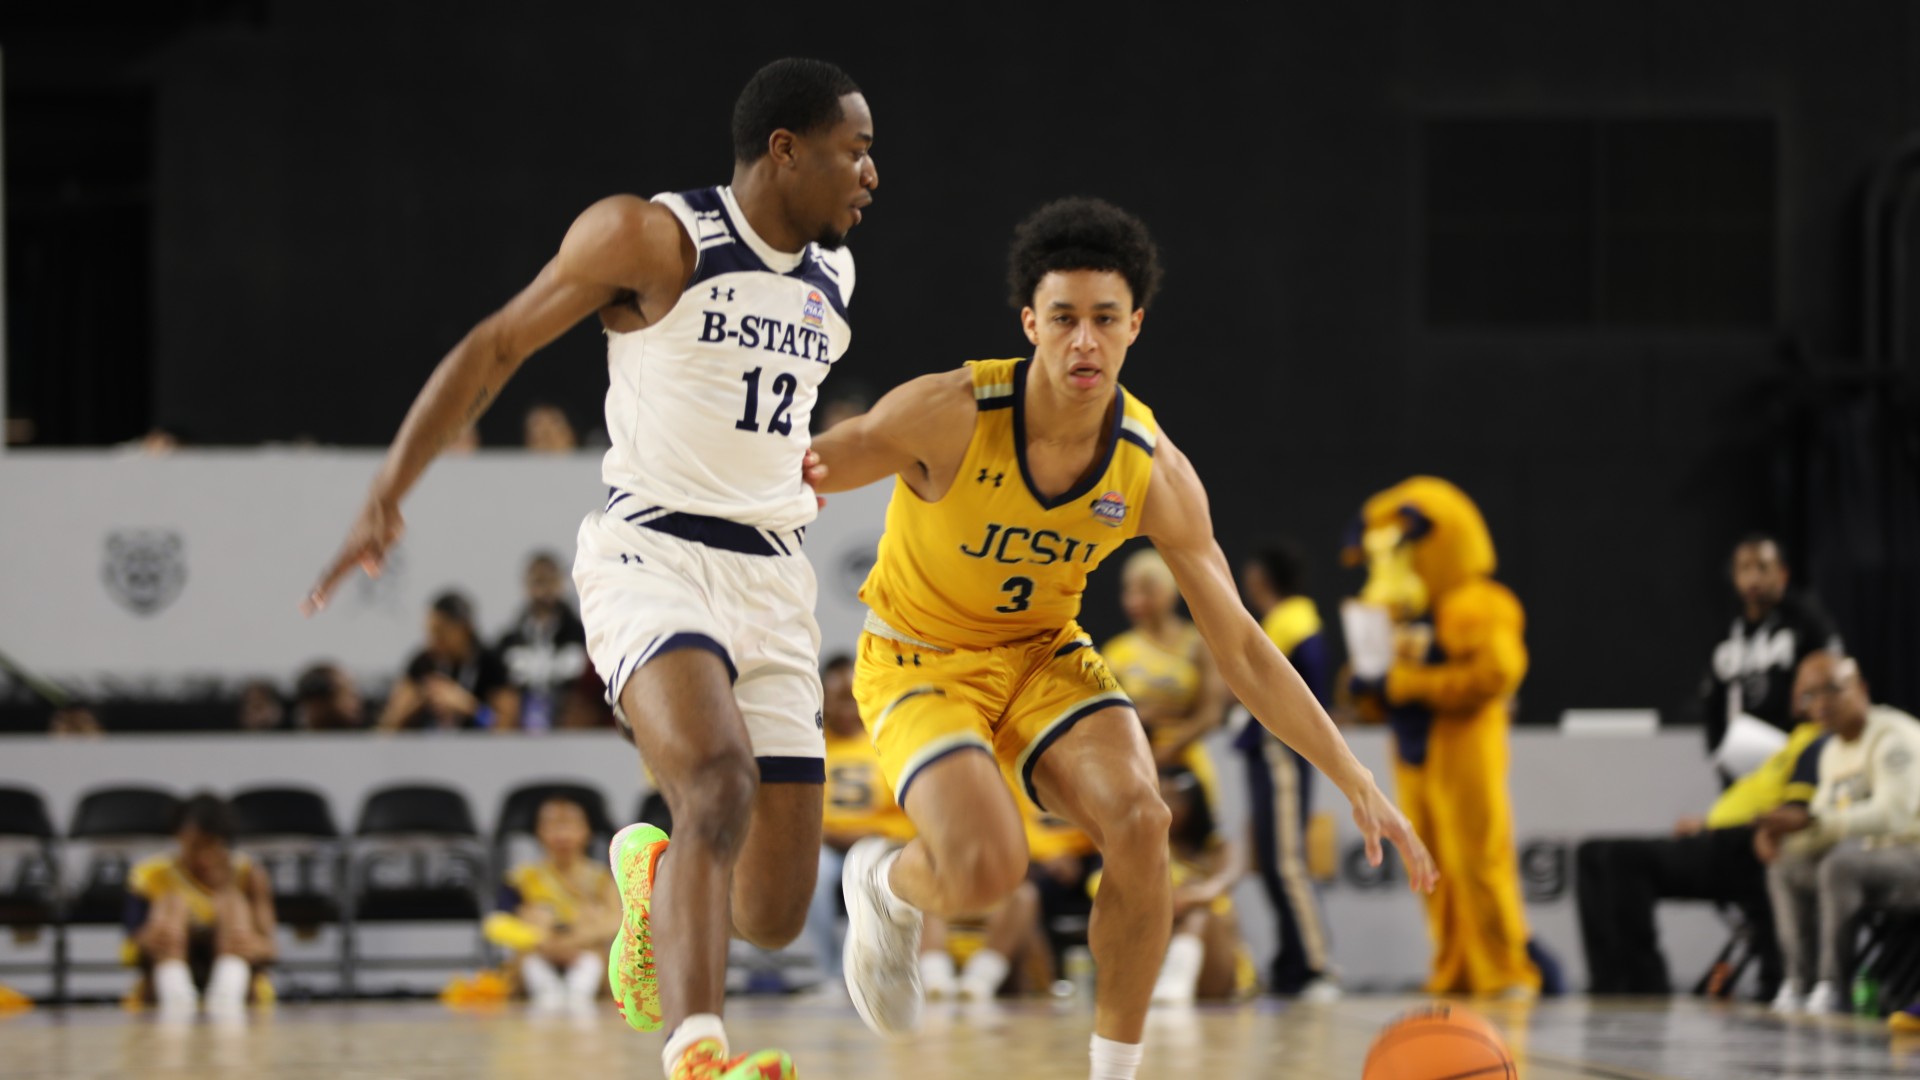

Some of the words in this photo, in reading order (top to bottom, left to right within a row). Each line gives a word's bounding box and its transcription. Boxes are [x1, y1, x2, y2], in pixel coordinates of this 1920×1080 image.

[698, 310, 830, 365] B-STATE
[735, 366, 798, 437] 12
[995, 576, 1035, 613] 3
